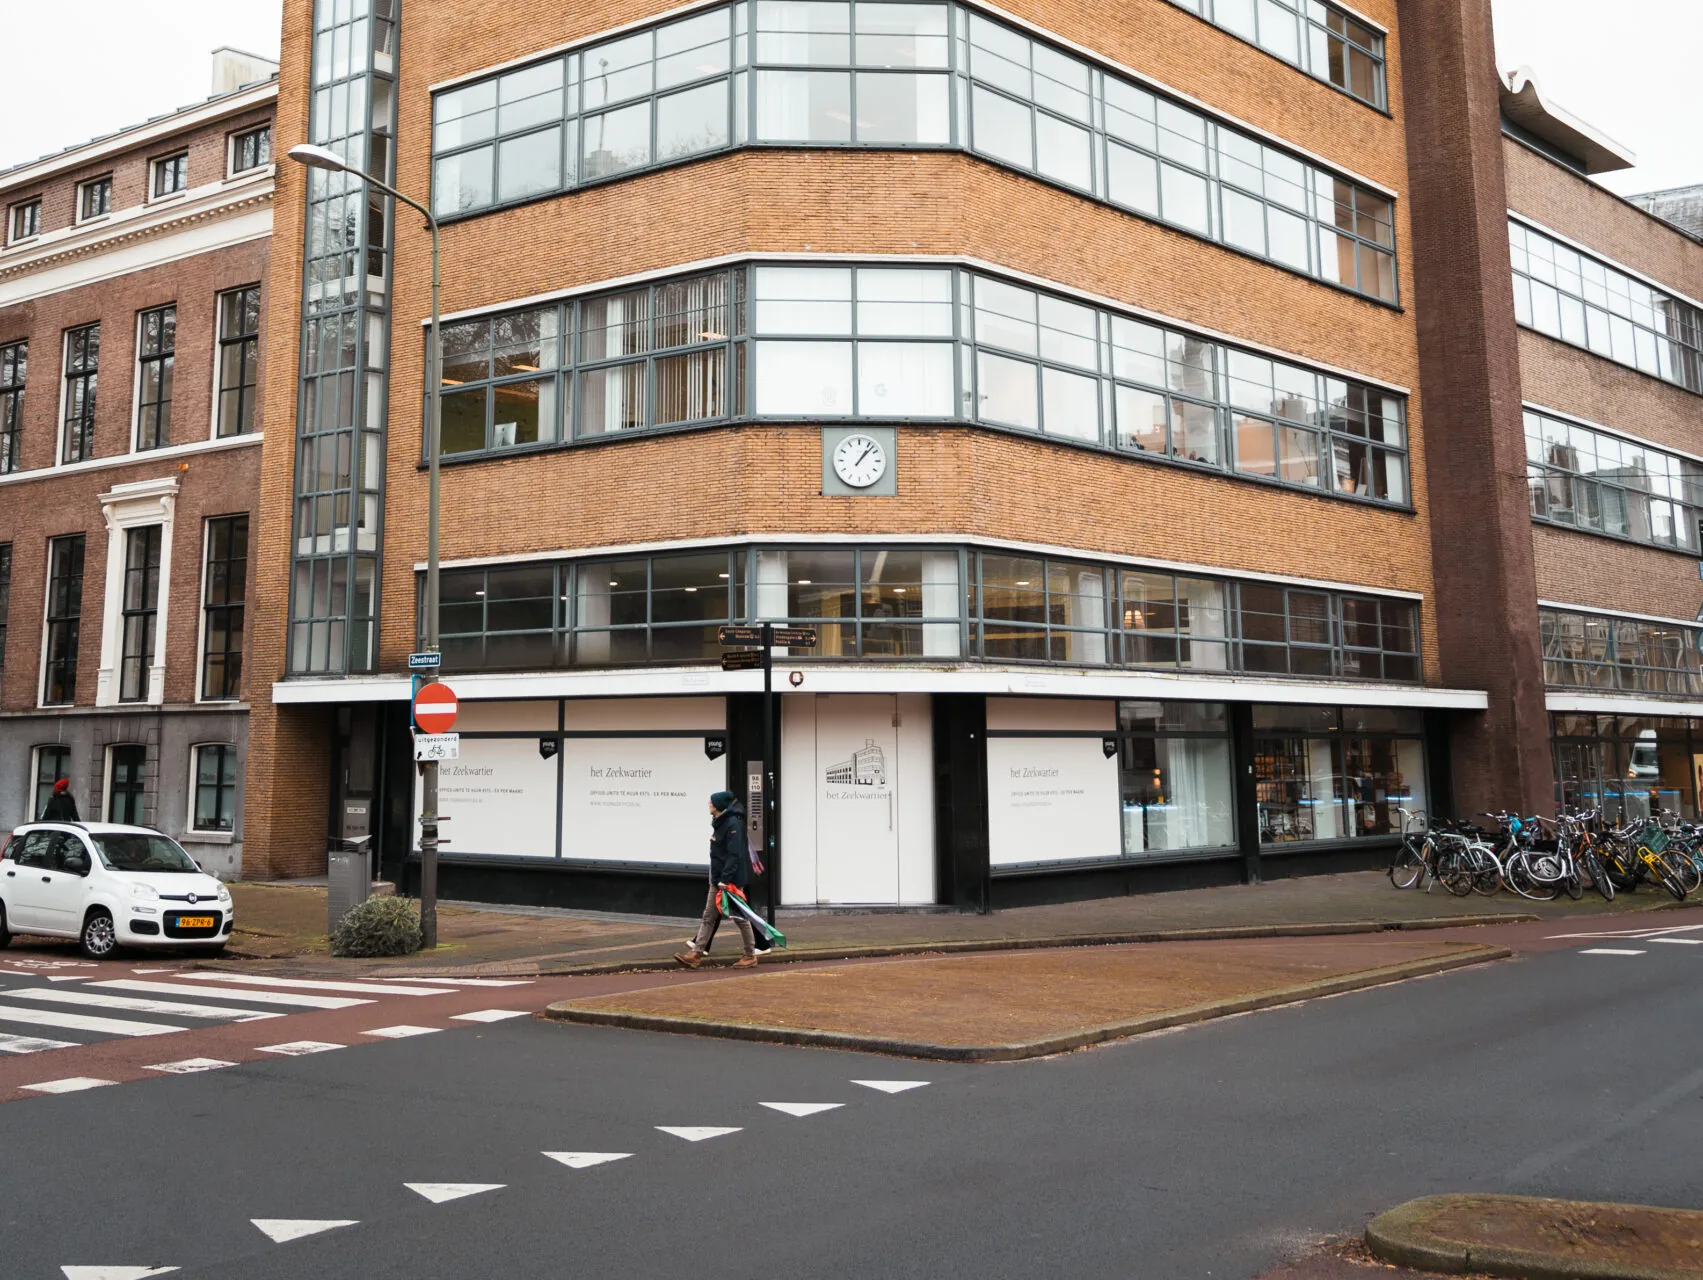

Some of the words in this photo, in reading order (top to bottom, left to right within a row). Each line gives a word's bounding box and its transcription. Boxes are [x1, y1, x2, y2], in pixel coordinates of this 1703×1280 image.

[411, 656, 438, 664] Zeestraat
[440, 765, 451, 776] het
[453, 764, 494, 776] Zeekwartier
[590, 765, 603, 778] het
[605, 765, 653, 778] Zeekwartier
[1010, 767, 1021, 779] het
[1022, 767, 1059, 779] Zeekwartier
[826, 790, 839, 800] het
[840, 790, 887, 800] Zeekwartier
[181, 918, 212, 926] 96-ZPR-6
